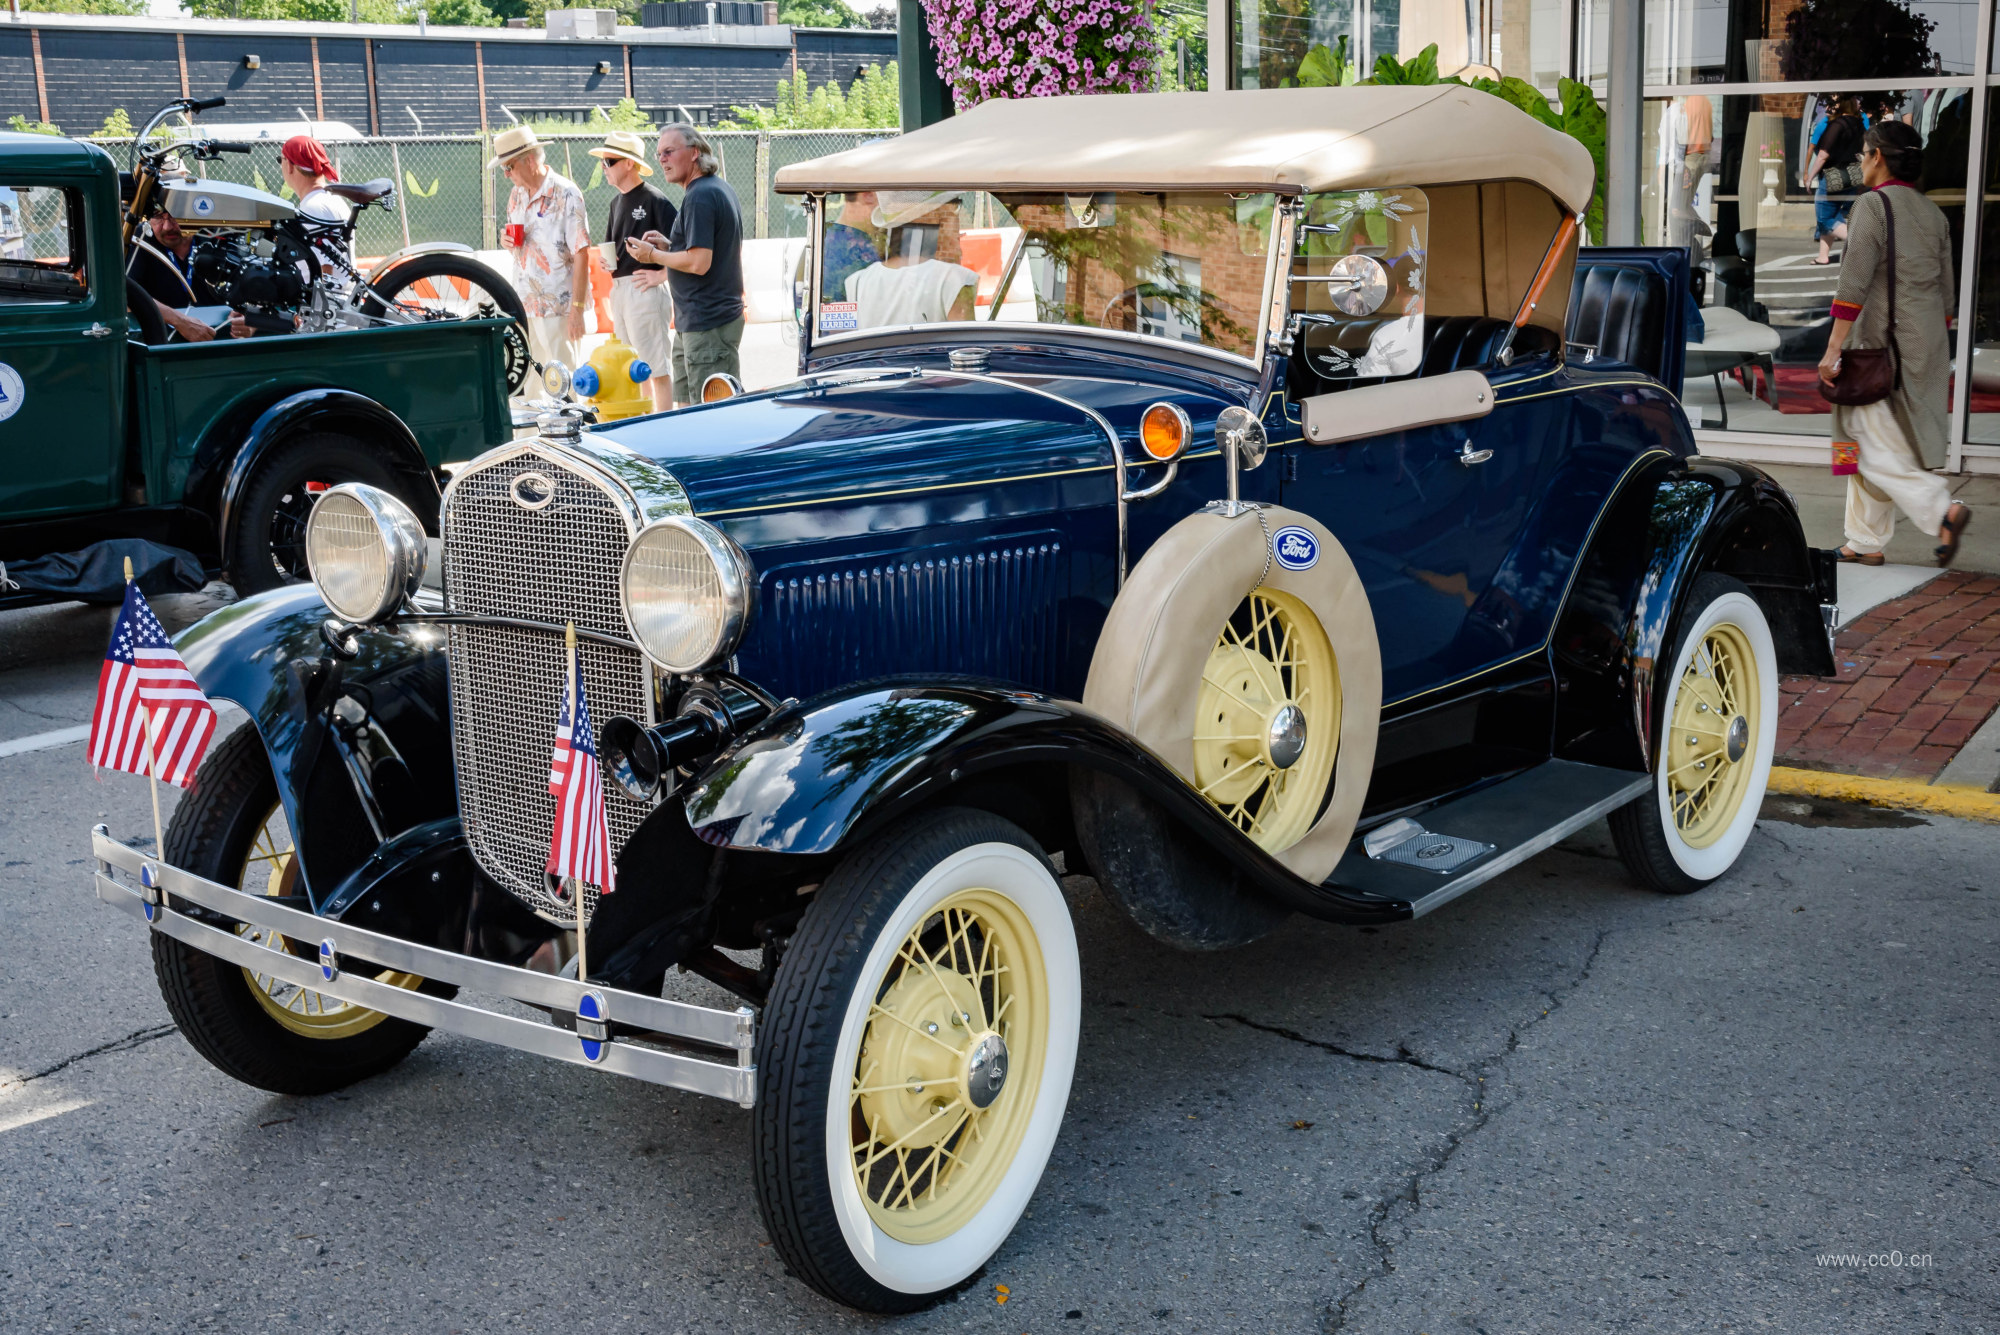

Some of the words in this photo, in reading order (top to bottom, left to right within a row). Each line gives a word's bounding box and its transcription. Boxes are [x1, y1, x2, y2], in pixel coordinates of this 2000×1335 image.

[822, 304, 857, 313] REMEMBER
[825, 312, 854, 320] PEARL
[822, 320, 856, 329] HARBOR
[1281, 534, 1312, 559] Ford
